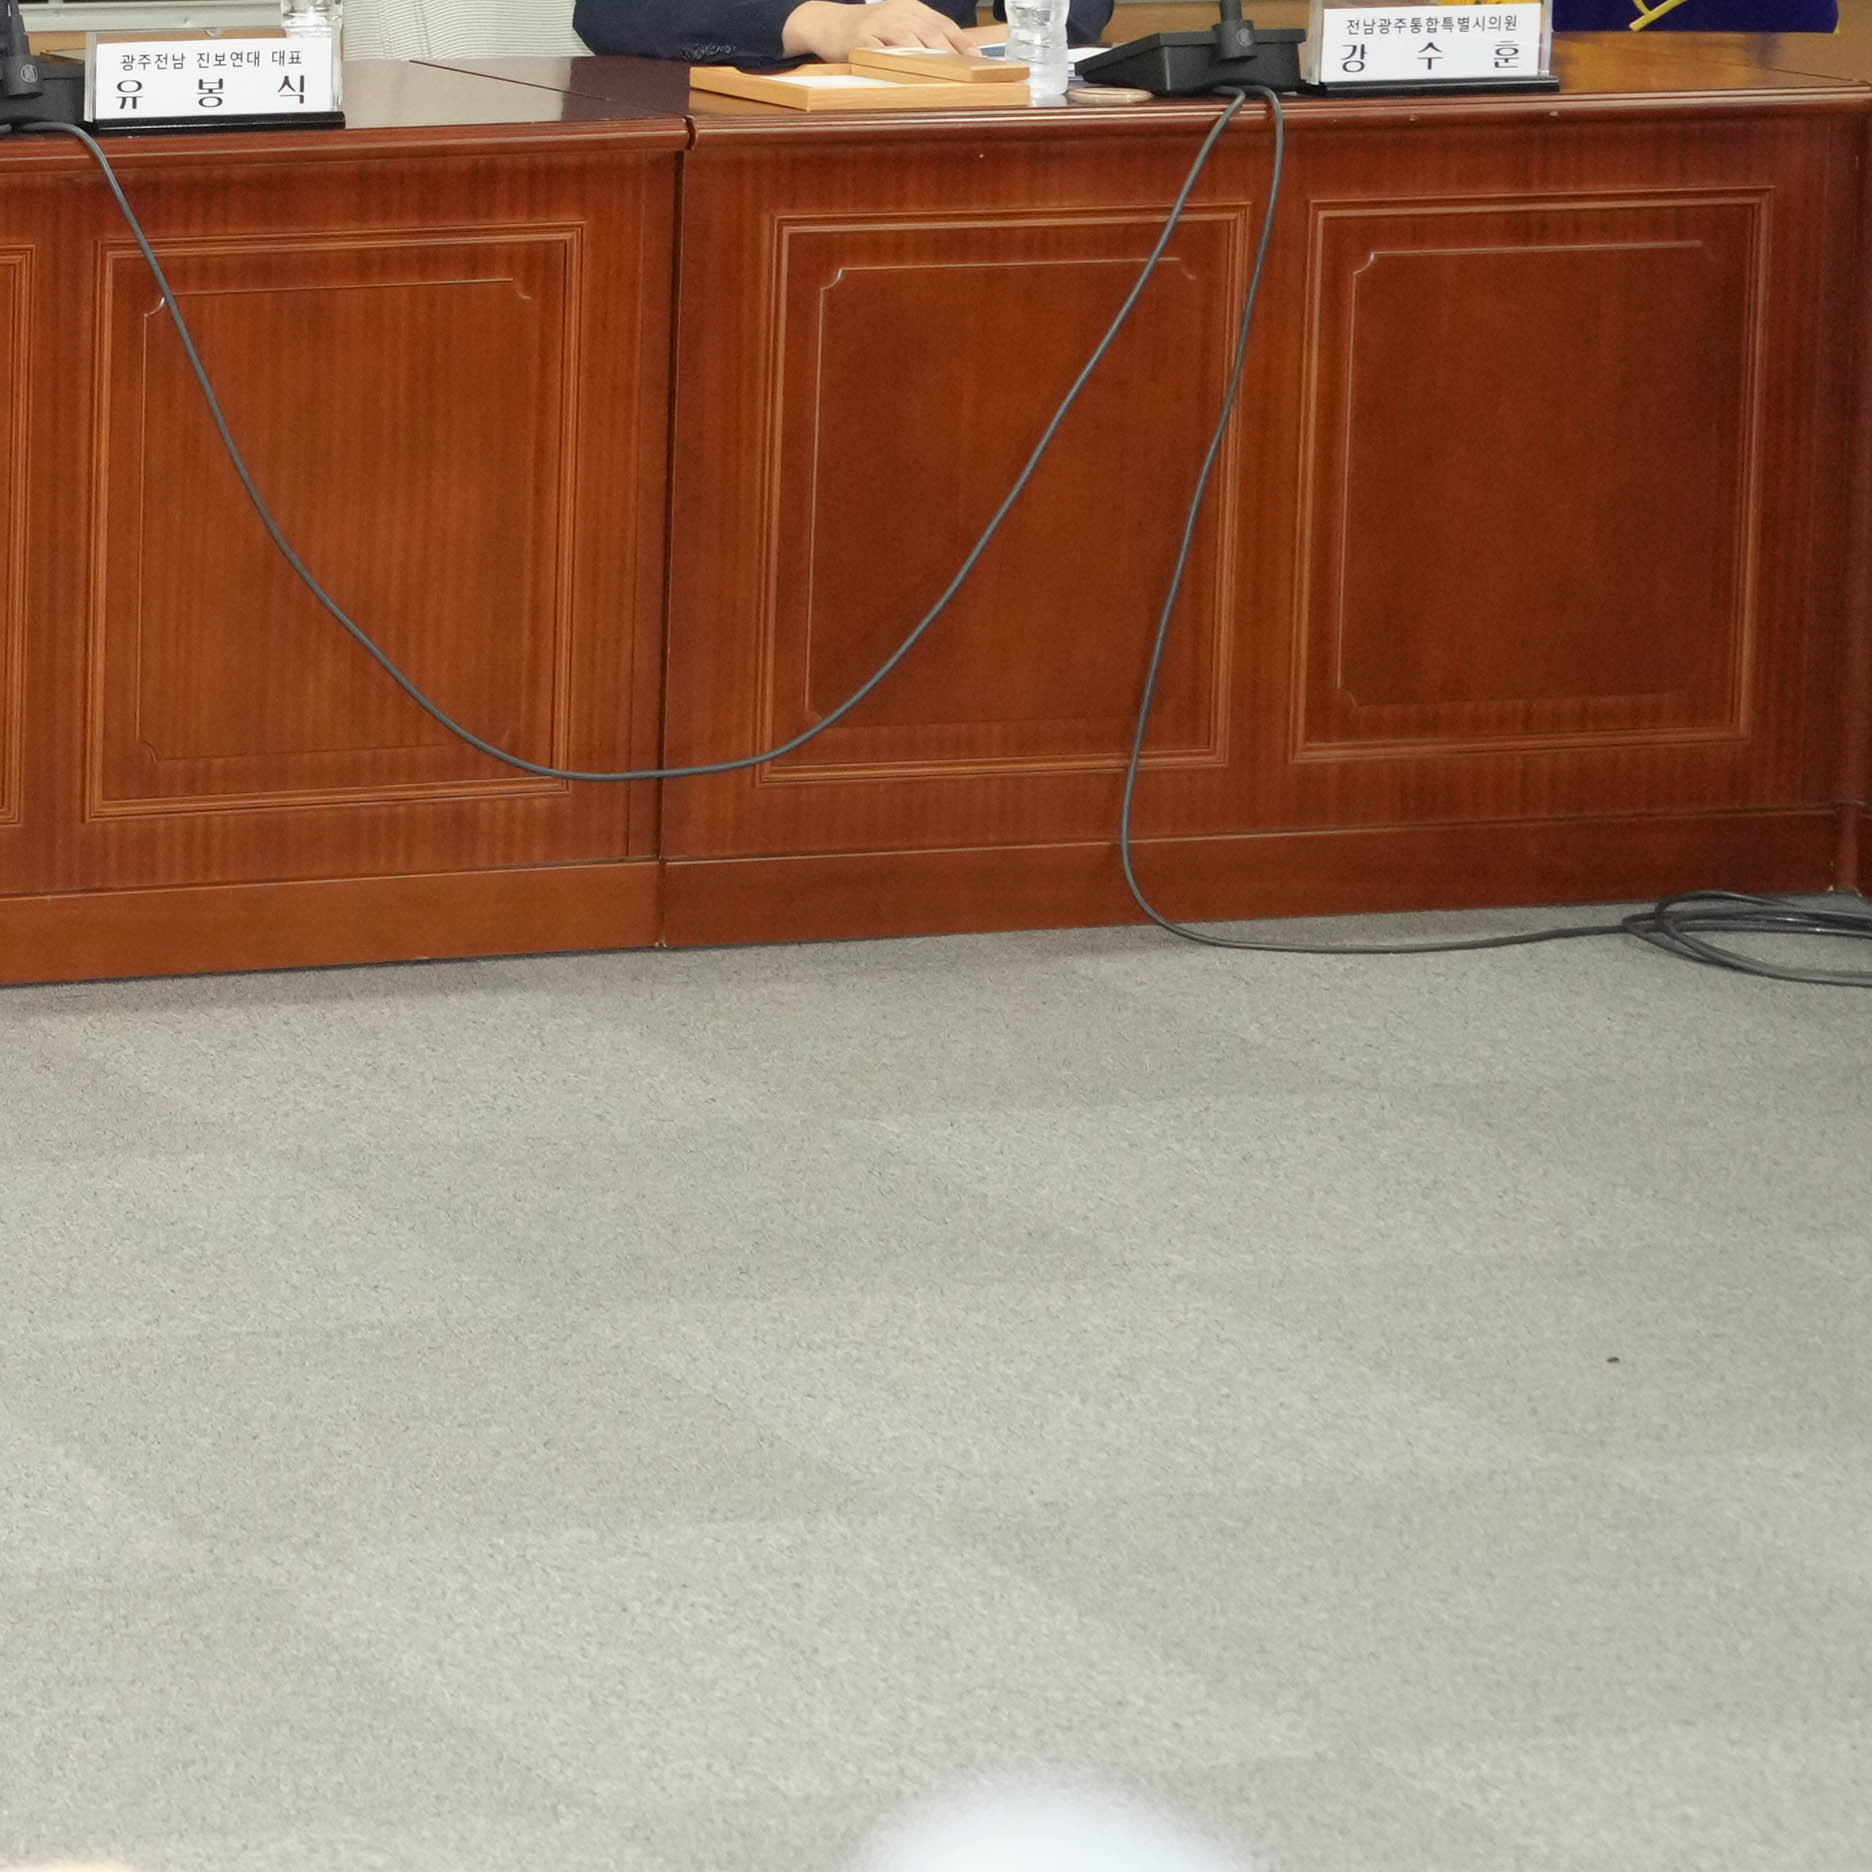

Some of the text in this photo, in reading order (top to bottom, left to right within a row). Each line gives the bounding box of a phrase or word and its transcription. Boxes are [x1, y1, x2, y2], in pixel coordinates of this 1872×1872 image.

[1346, 14, 1519, 36] 전남광주통합특별시의원
[120, 50, 304, 72] 광주전남 진보연대 대표
